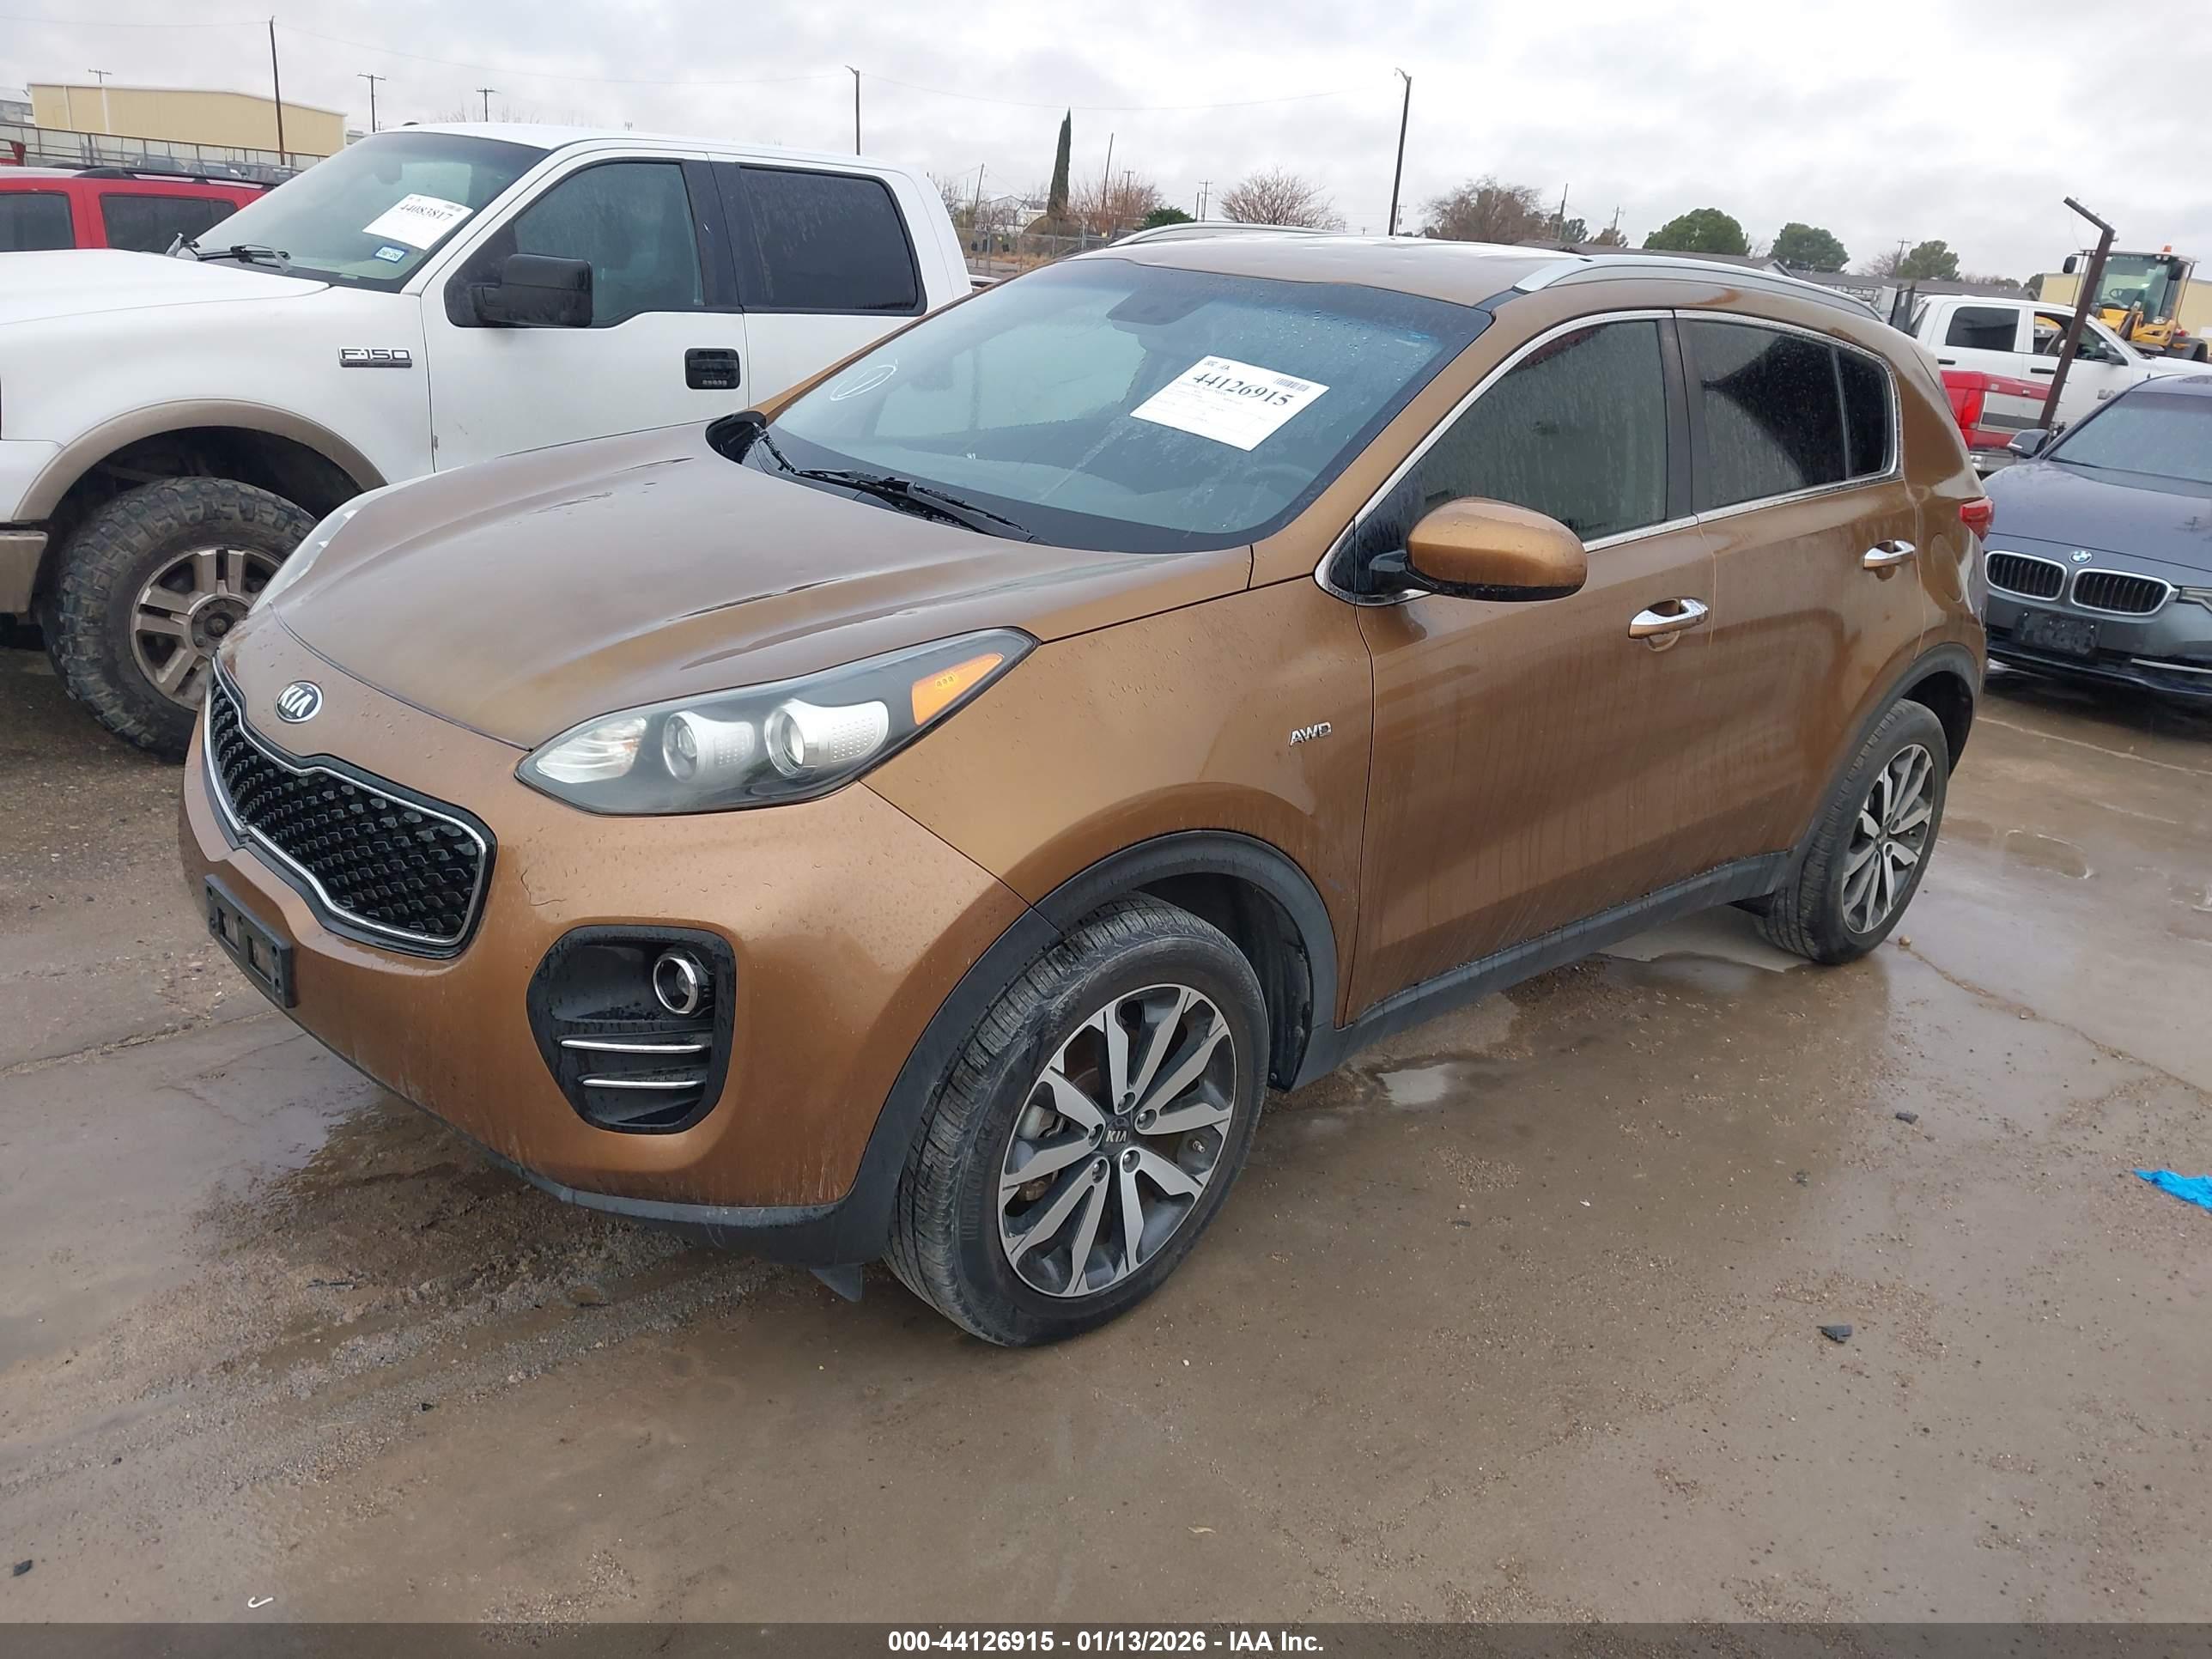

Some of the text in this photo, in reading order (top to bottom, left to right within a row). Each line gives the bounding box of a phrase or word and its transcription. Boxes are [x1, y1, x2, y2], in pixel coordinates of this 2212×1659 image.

[399, 204, 454, 221] 44083817
[340, 348, 411, 360] F-150
[1193, 372, 1295, 406] 44126915
[278, 684, 314, 718] KIA
[1289, 721, 1332, 746] AWD
[1105, 1130, 1127, 1142] KIA
